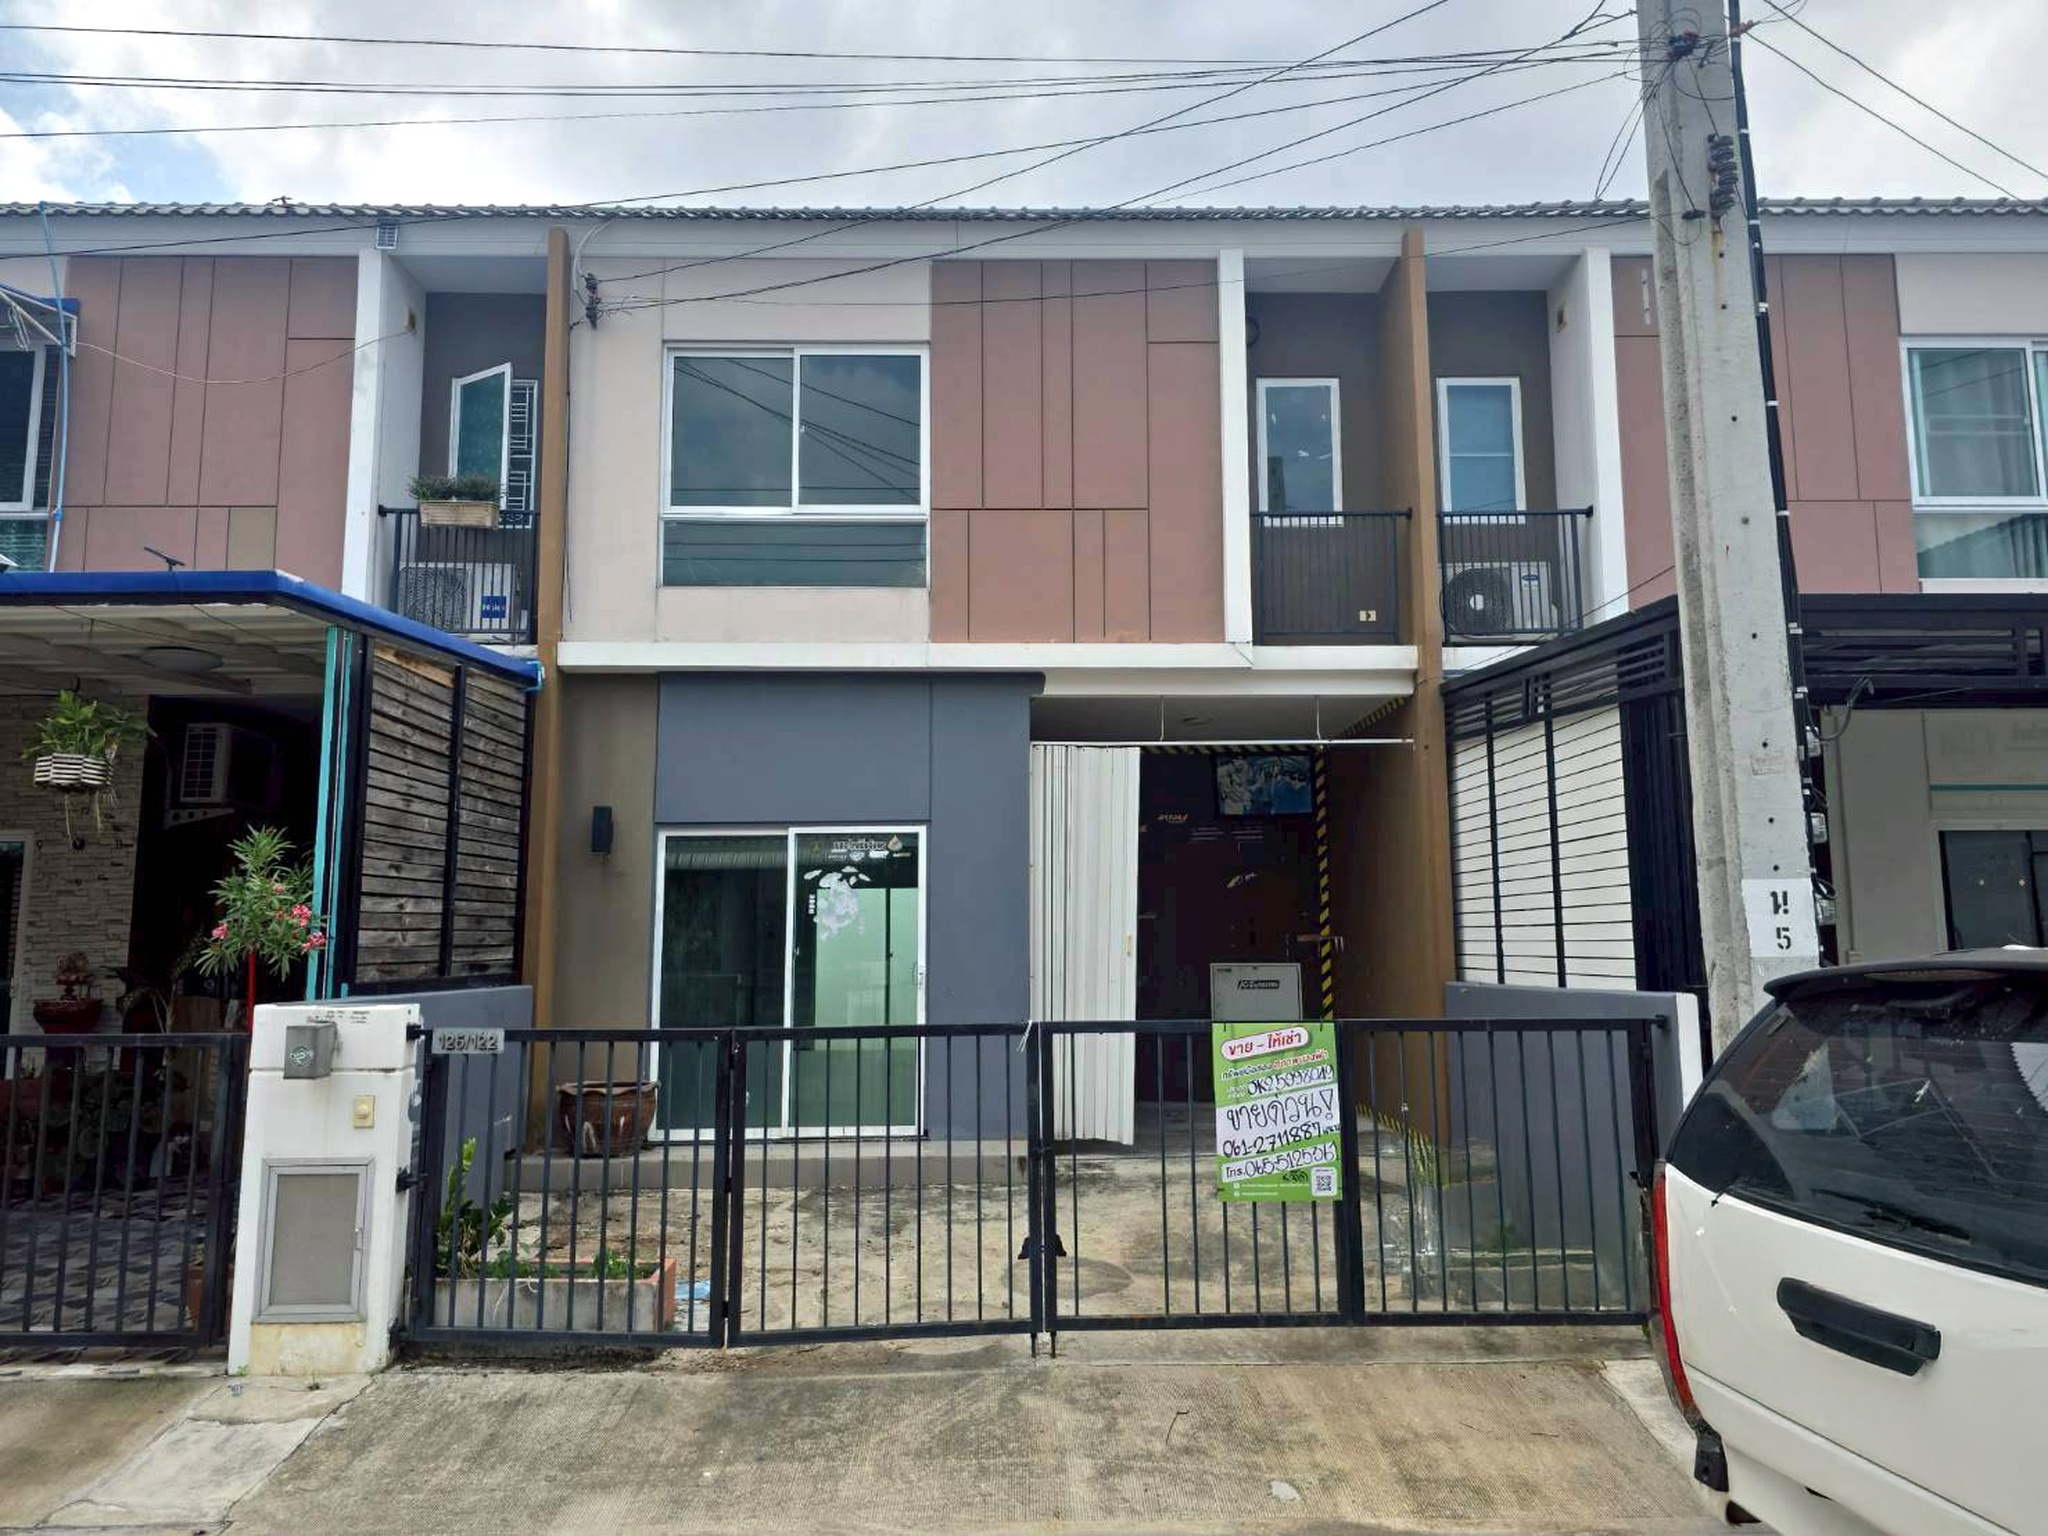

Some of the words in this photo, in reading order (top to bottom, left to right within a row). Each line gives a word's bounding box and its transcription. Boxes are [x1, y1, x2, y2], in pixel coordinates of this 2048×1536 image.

[1776, 926, 1792, 950] 5
[1228, 1041, 1253, 1056] ขาย
[1267, 1030, 1301, 1050] ให้เช่า
